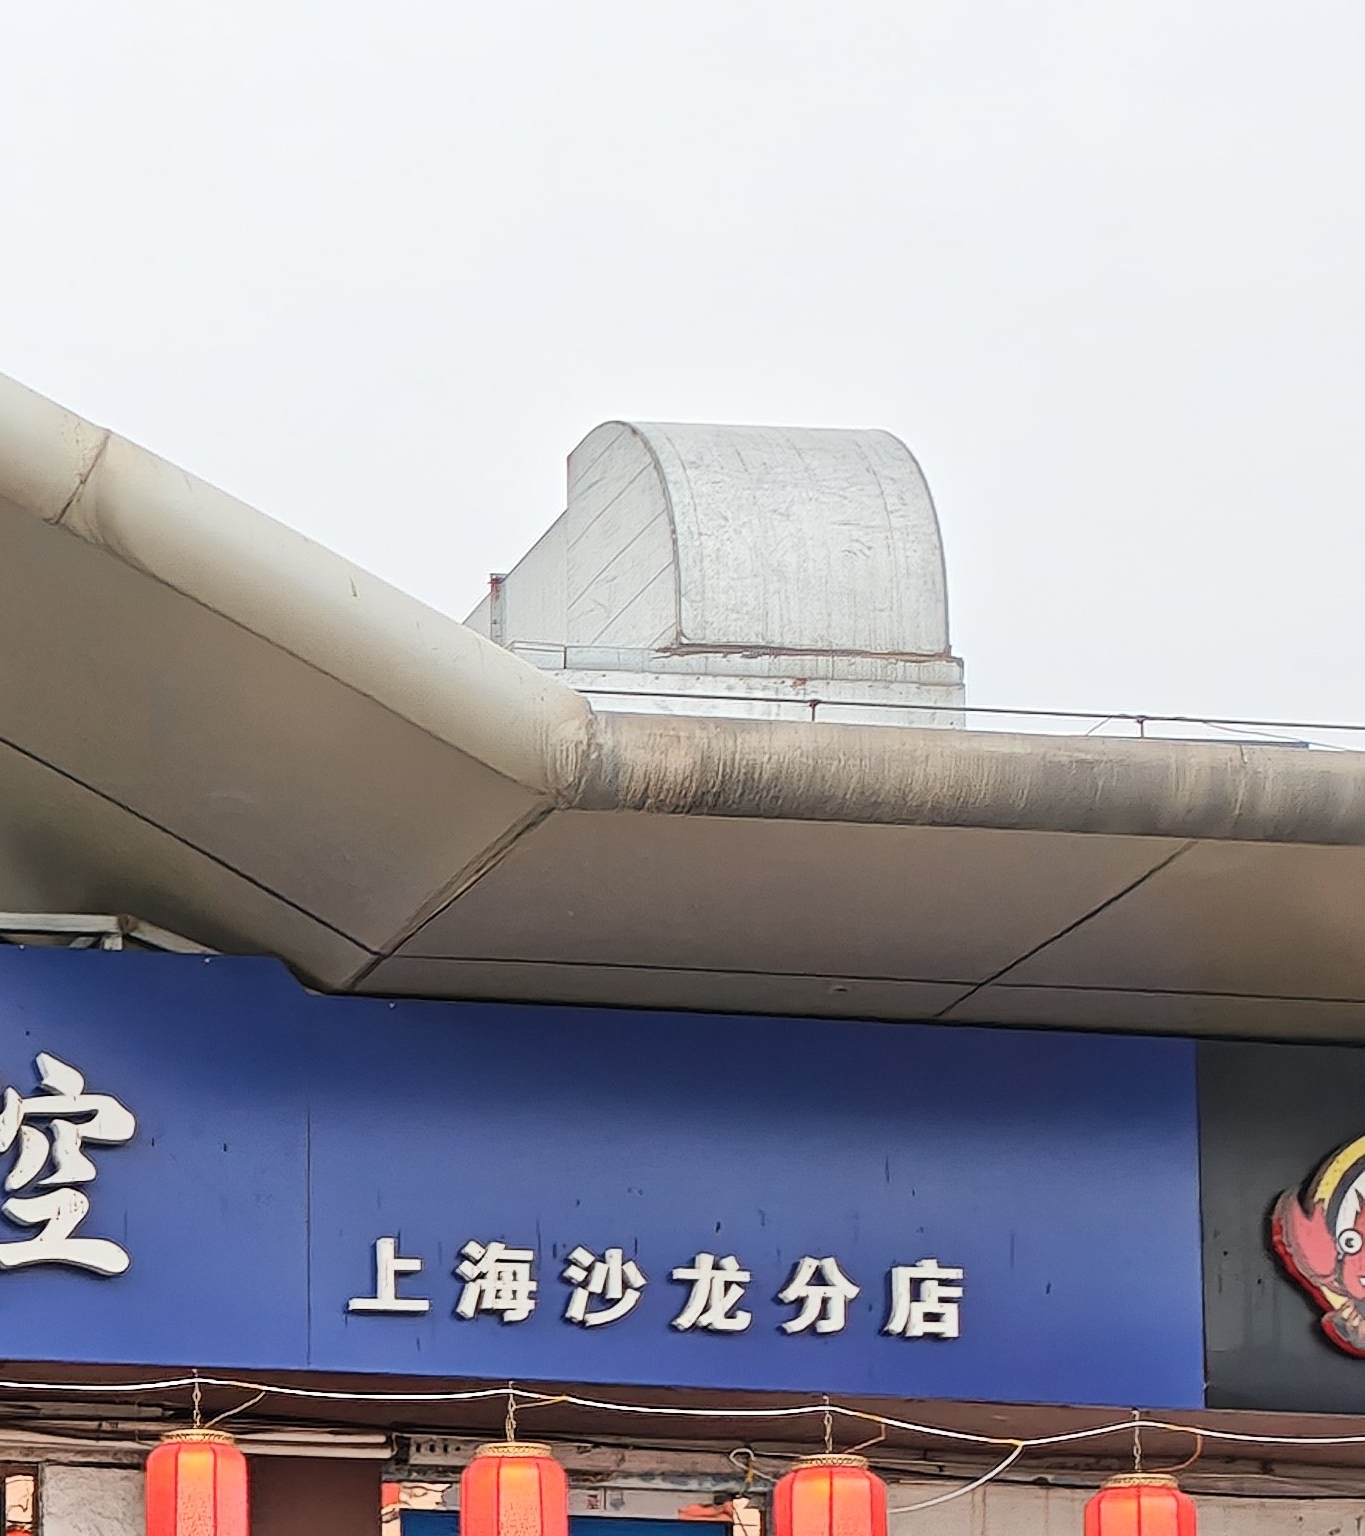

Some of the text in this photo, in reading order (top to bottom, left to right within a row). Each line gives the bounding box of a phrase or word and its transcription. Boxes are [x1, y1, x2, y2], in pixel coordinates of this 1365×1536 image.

[347, 1236, 965, 1338] 上海沙龙分店
